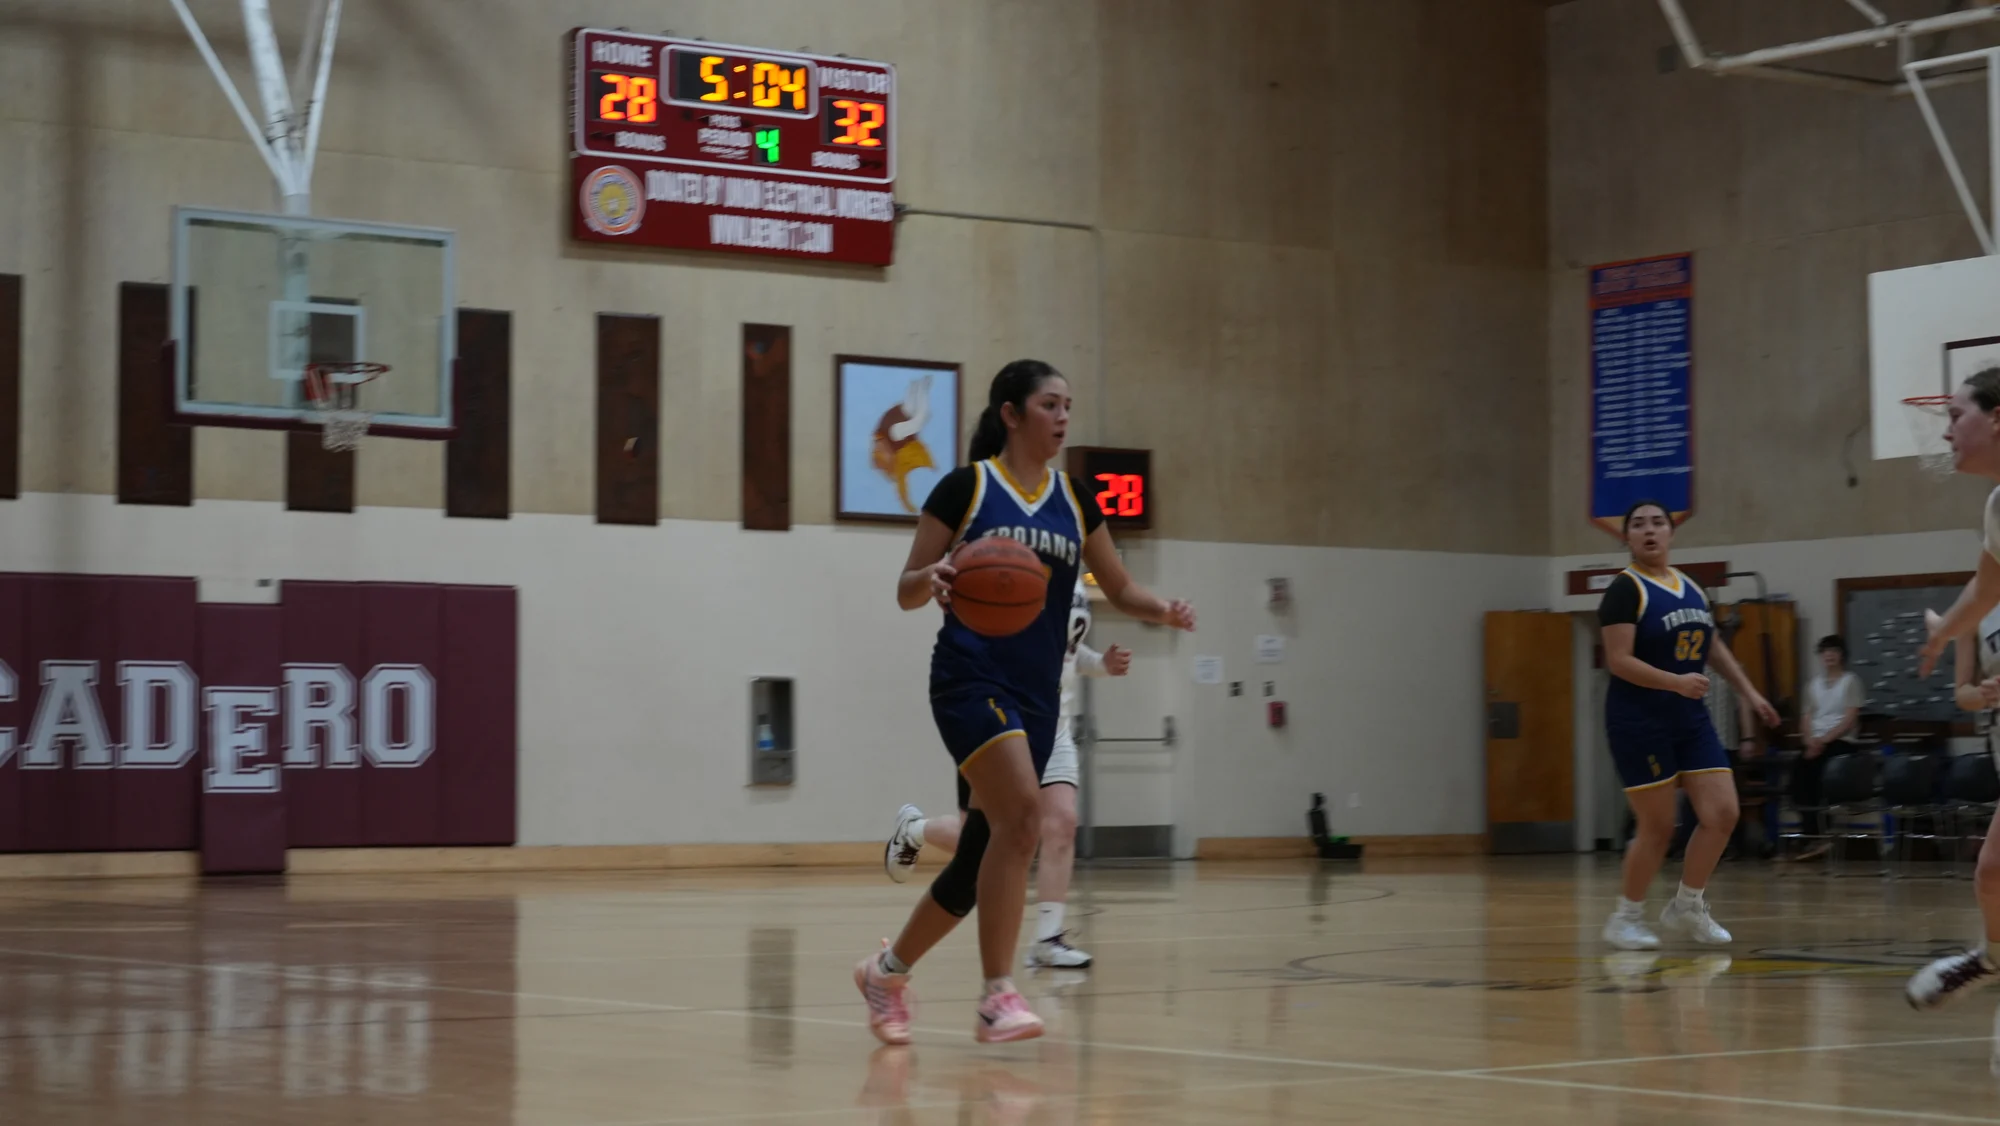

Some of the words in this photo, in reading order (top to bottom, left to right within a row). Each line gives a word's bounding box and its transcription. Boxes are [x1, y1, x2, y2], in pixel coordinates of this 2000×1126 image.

[591, 40, 653, 68] HOME
[600, 73, 657, 123] 28
[700, 56, 806, 111] 5:04
[755, 128, 780, 163] 4
[832, 100, 885, 148] 32
[1095, 473, 1144, 517] 28
[1674, 629, 1705, 661] 52
[0, 657, 437, 793] ADERO
